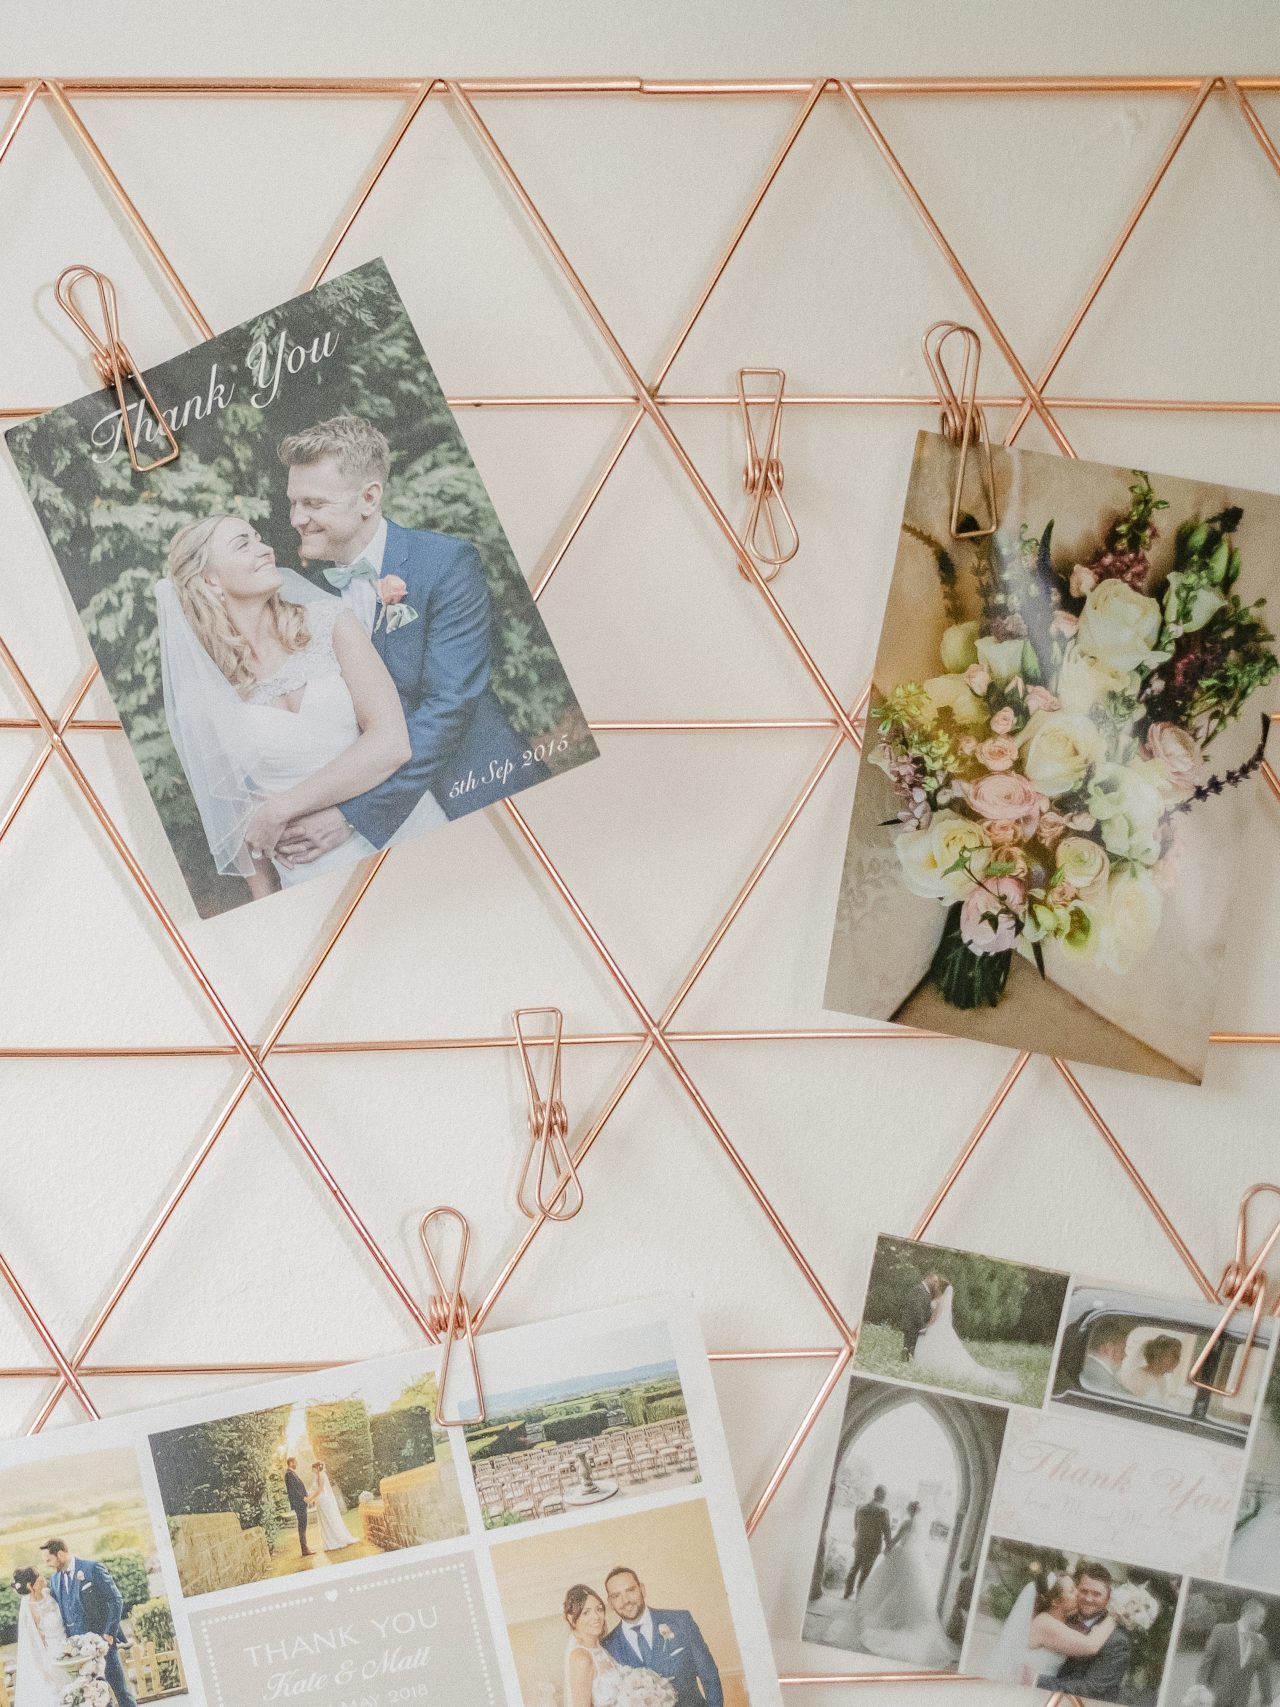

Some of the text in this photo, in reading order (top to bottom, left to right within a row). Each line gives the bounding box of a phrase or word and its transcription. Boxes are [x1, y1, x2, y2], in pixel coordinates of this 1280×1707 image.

[91, 330, 340, 464] Thank You
[449, 735, 569, 799] 5th Sep 2015
[1007, 1440, 1139, 1494] Thank
[1152, 1467, 1234, 1516] You
[243, 1606, 440, 1668] THANK YOU
[263, 1645, 431, 1702] Kate & Matt
[387, 1683, 429, 1703] 2018
